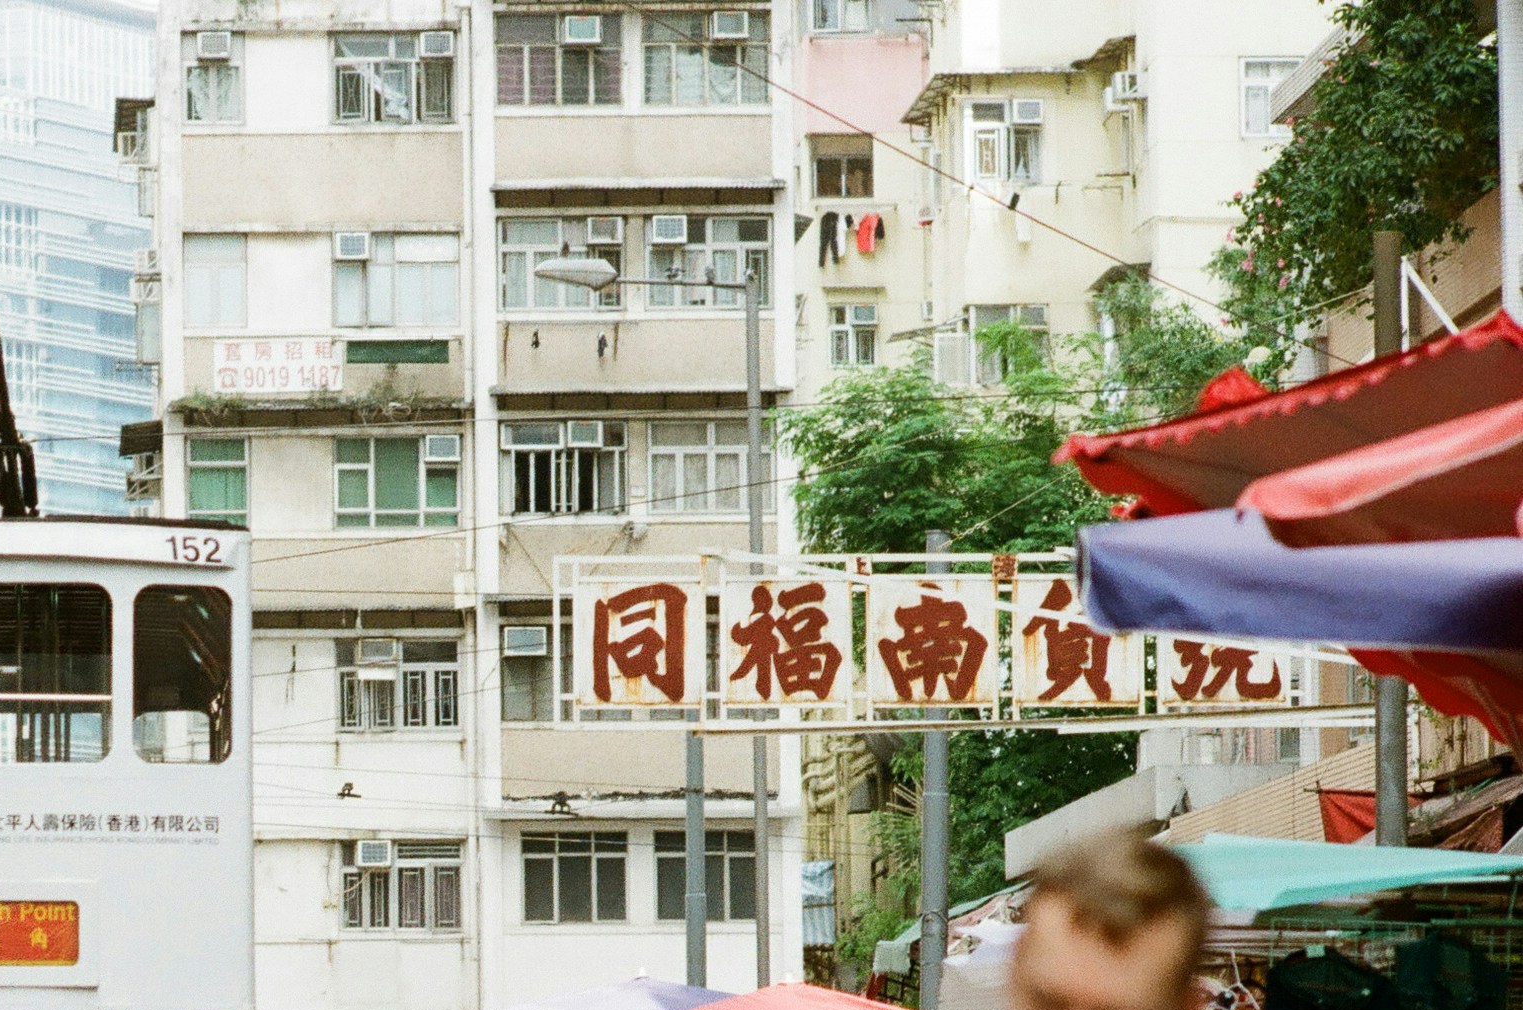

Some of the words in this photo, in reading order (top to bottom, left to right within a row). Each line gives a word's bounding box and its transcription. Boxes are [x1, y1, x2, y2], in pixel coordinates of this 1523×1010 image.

[225, 341, 333, 360] 套房招租
[244, 366, 290, 388] 9019
[297, 365, 341, 388] 1187
[165, 535, 221, 563] 152
[19, 903, 76, 922] Point
